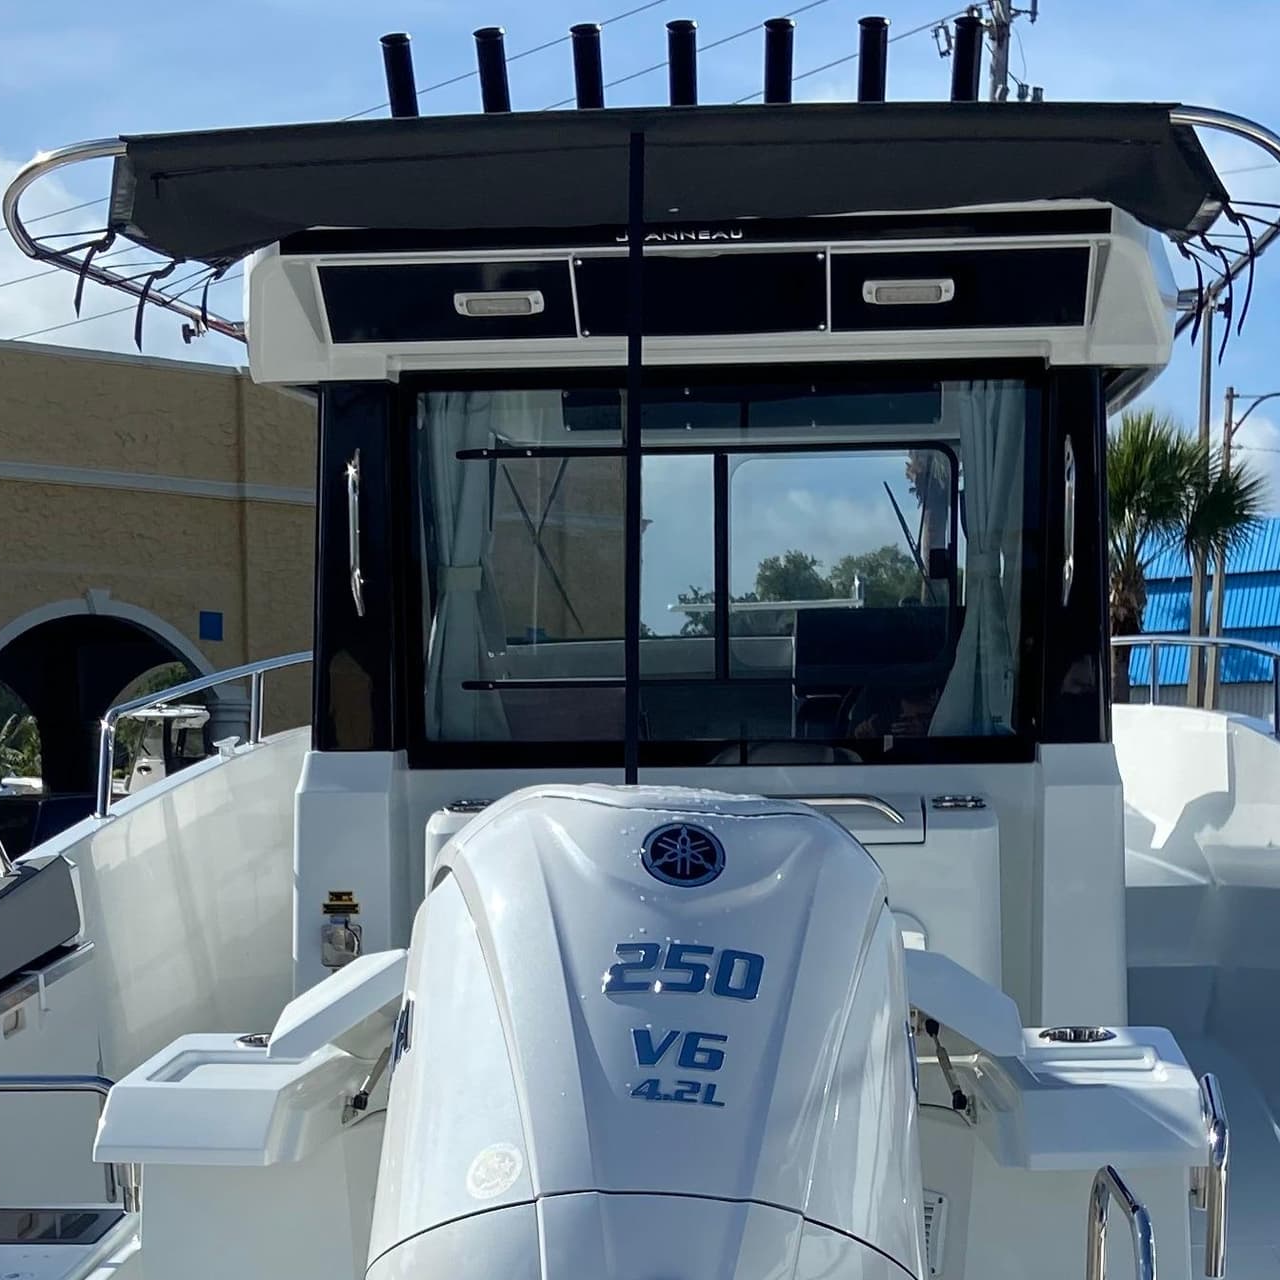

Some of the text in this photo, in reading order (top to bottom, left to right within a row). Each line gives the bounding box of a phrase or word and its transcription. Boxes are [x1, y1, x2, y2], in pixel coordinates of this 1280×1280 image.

[616, 228, 743, 242] JANNEAU
[604, 943, 764, 1001] 250
[632, 1029, 728, 1071] V6
[631, 1078, 725, 1107] 4.2L
